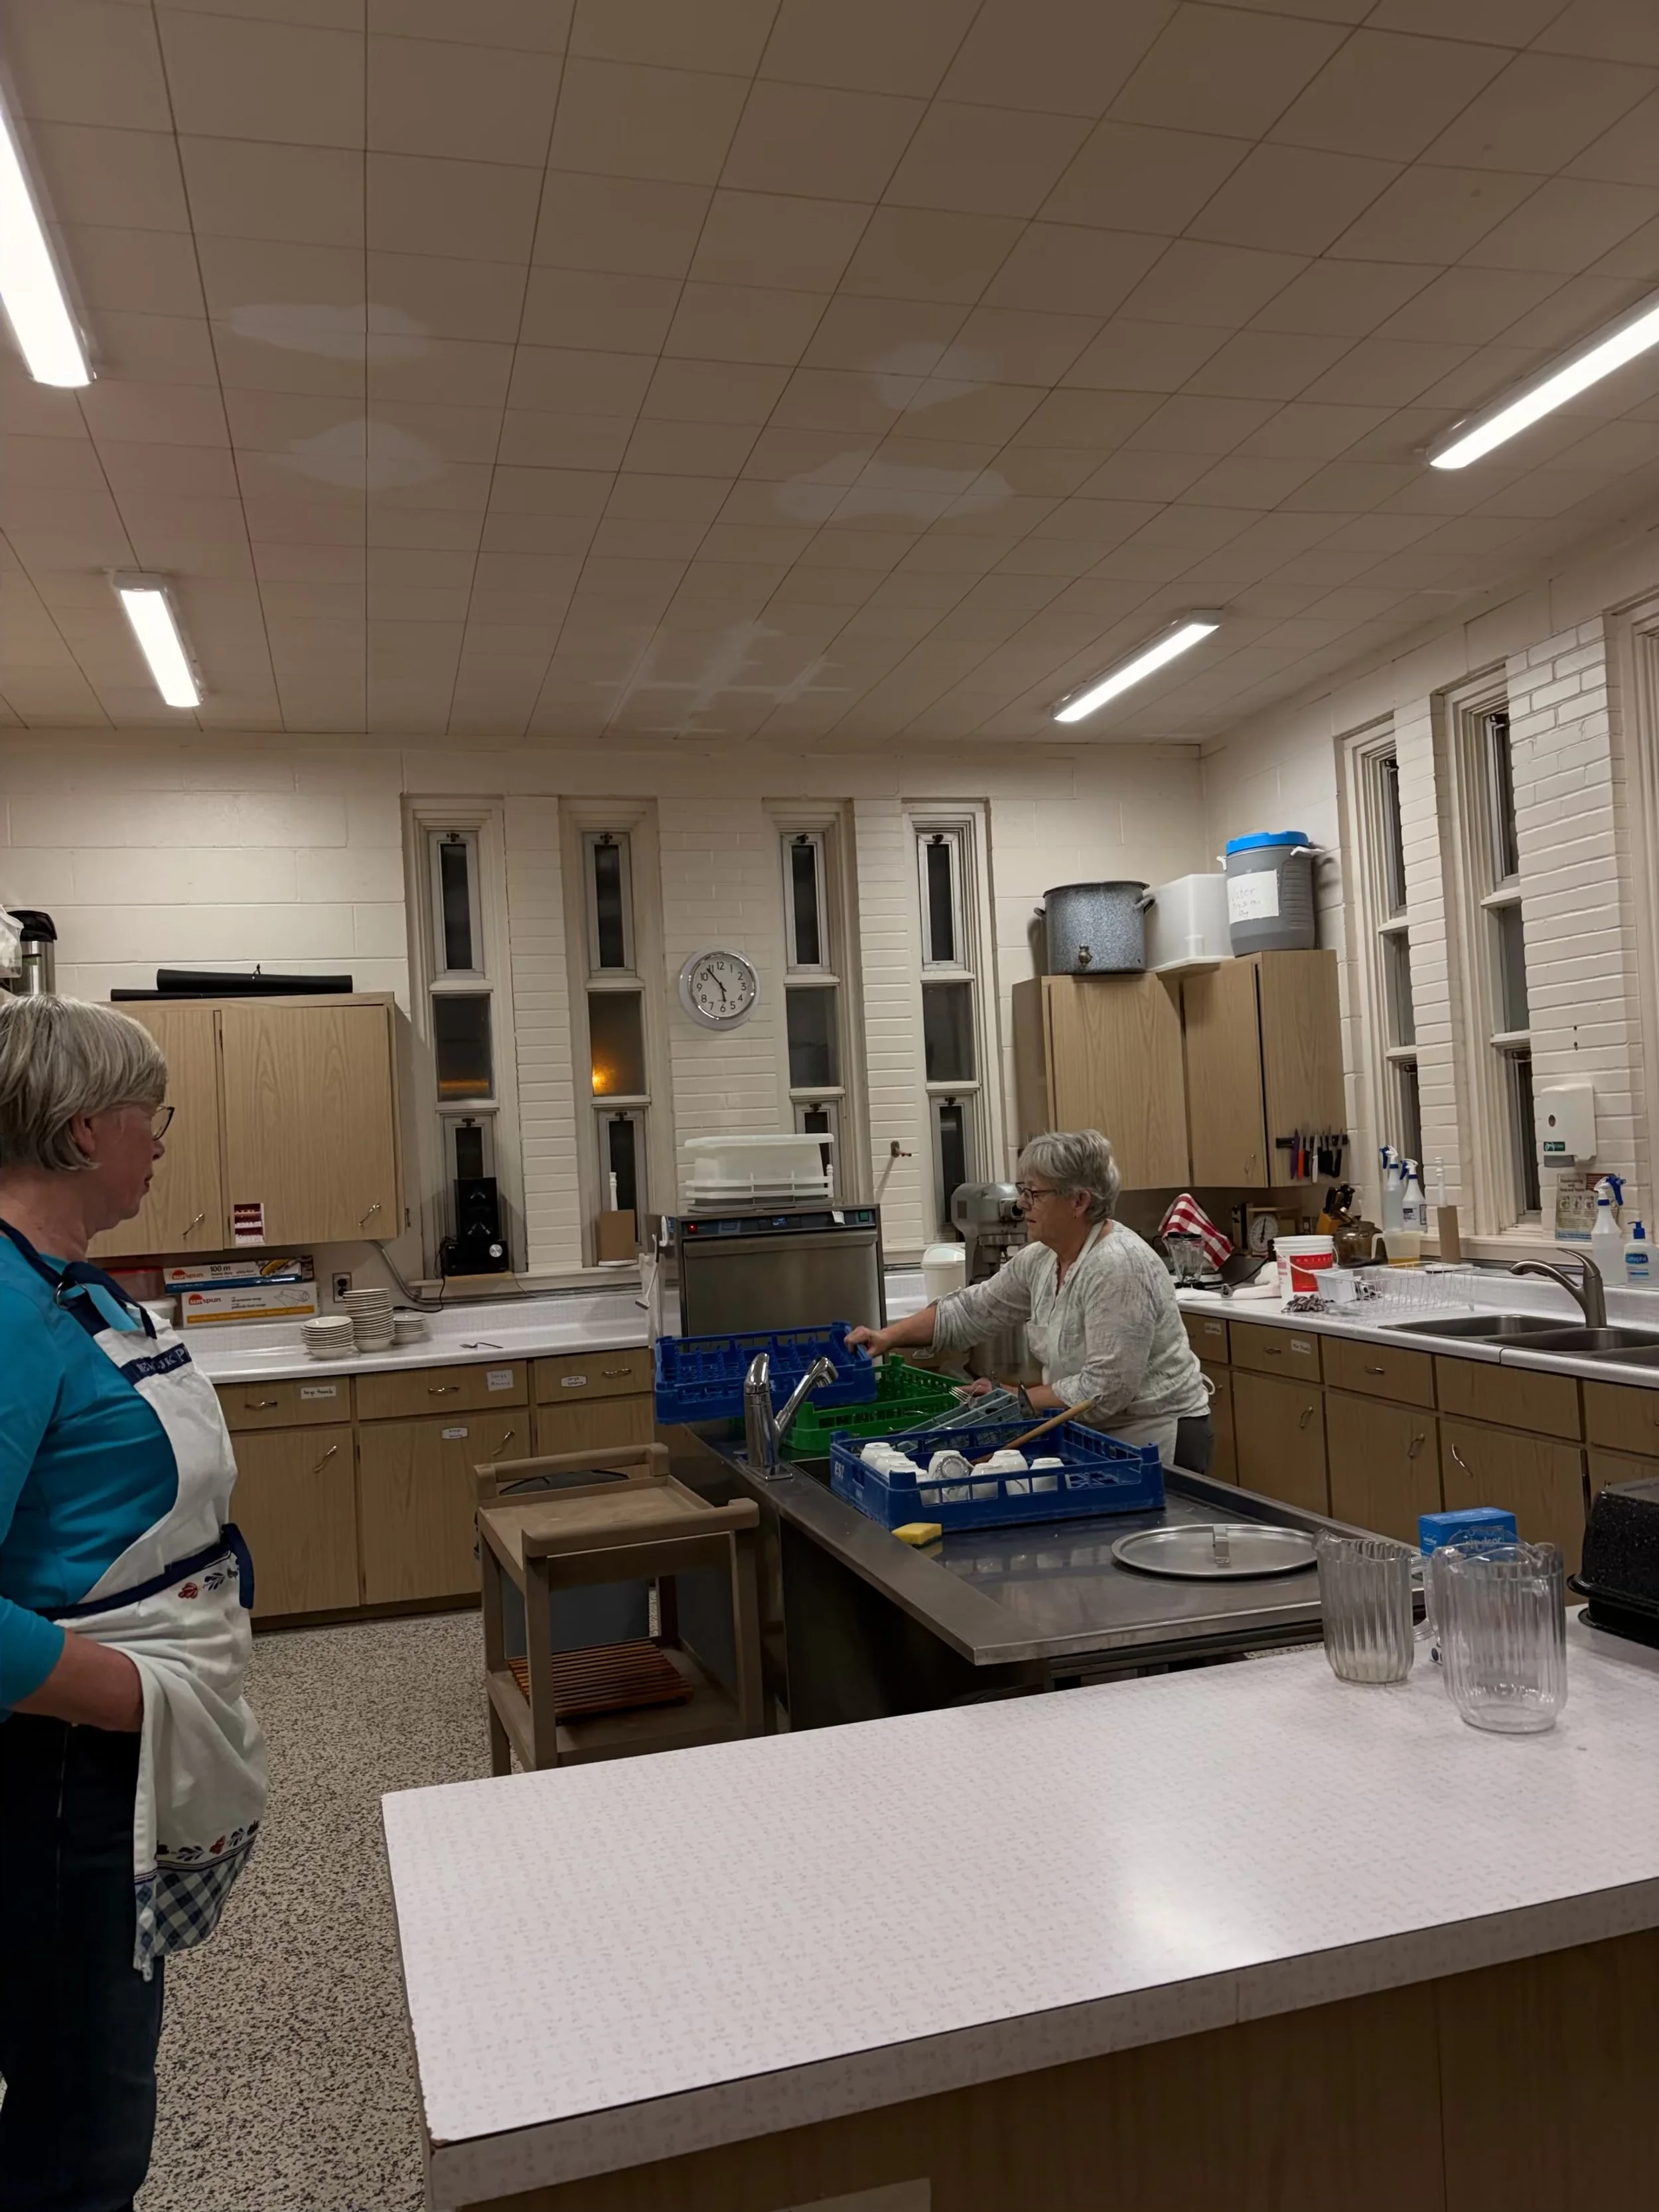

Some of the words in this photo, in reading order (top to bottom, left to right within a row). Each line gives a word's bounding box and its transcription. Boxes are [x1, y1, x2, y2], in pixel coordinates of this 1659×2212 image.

[708, 964, 714, 973] 11
[717, 961, 725, 970] 12
[700, 972, 709, 981] 10
[737, 972, 743, 980] 2
[696, 983, 702, 992] 9
[741, 982, 747, 991] 3
[701, 994, 707, 1003] 8
[708, 1001, 714, 1010] 7
[720, 1003, 726, 1013] 6
[730, 1001, 736, 1009] 5
